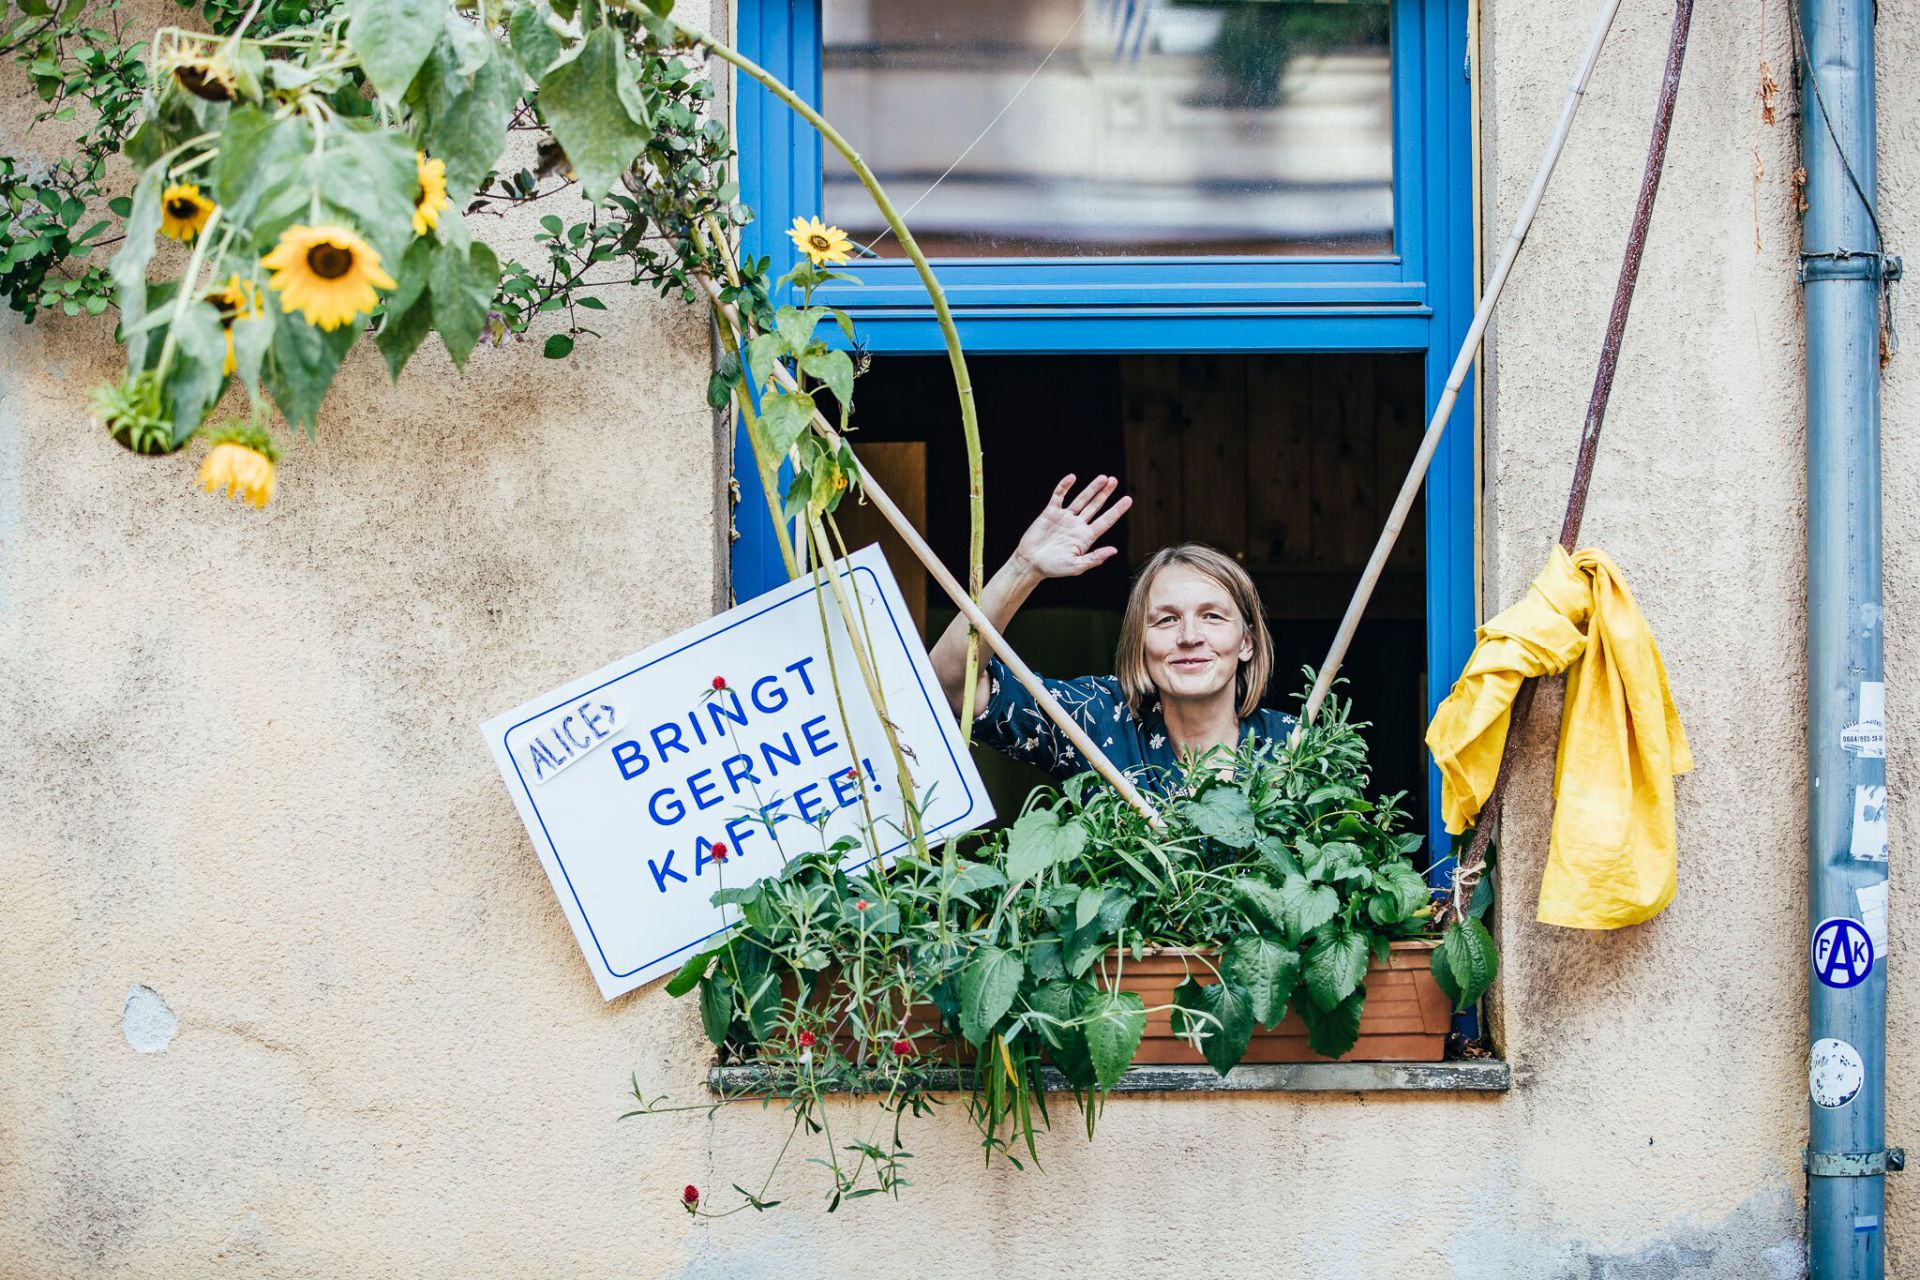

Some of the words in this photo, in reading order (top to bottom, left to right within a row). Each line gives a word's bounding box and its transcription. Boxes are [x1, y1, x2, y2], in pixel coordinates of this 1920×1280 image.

[611, 656, 814, 781] BRINGT
[648, 714, 839, 826] GERNE
[647, 757, 882, 894] KAFFEE!
